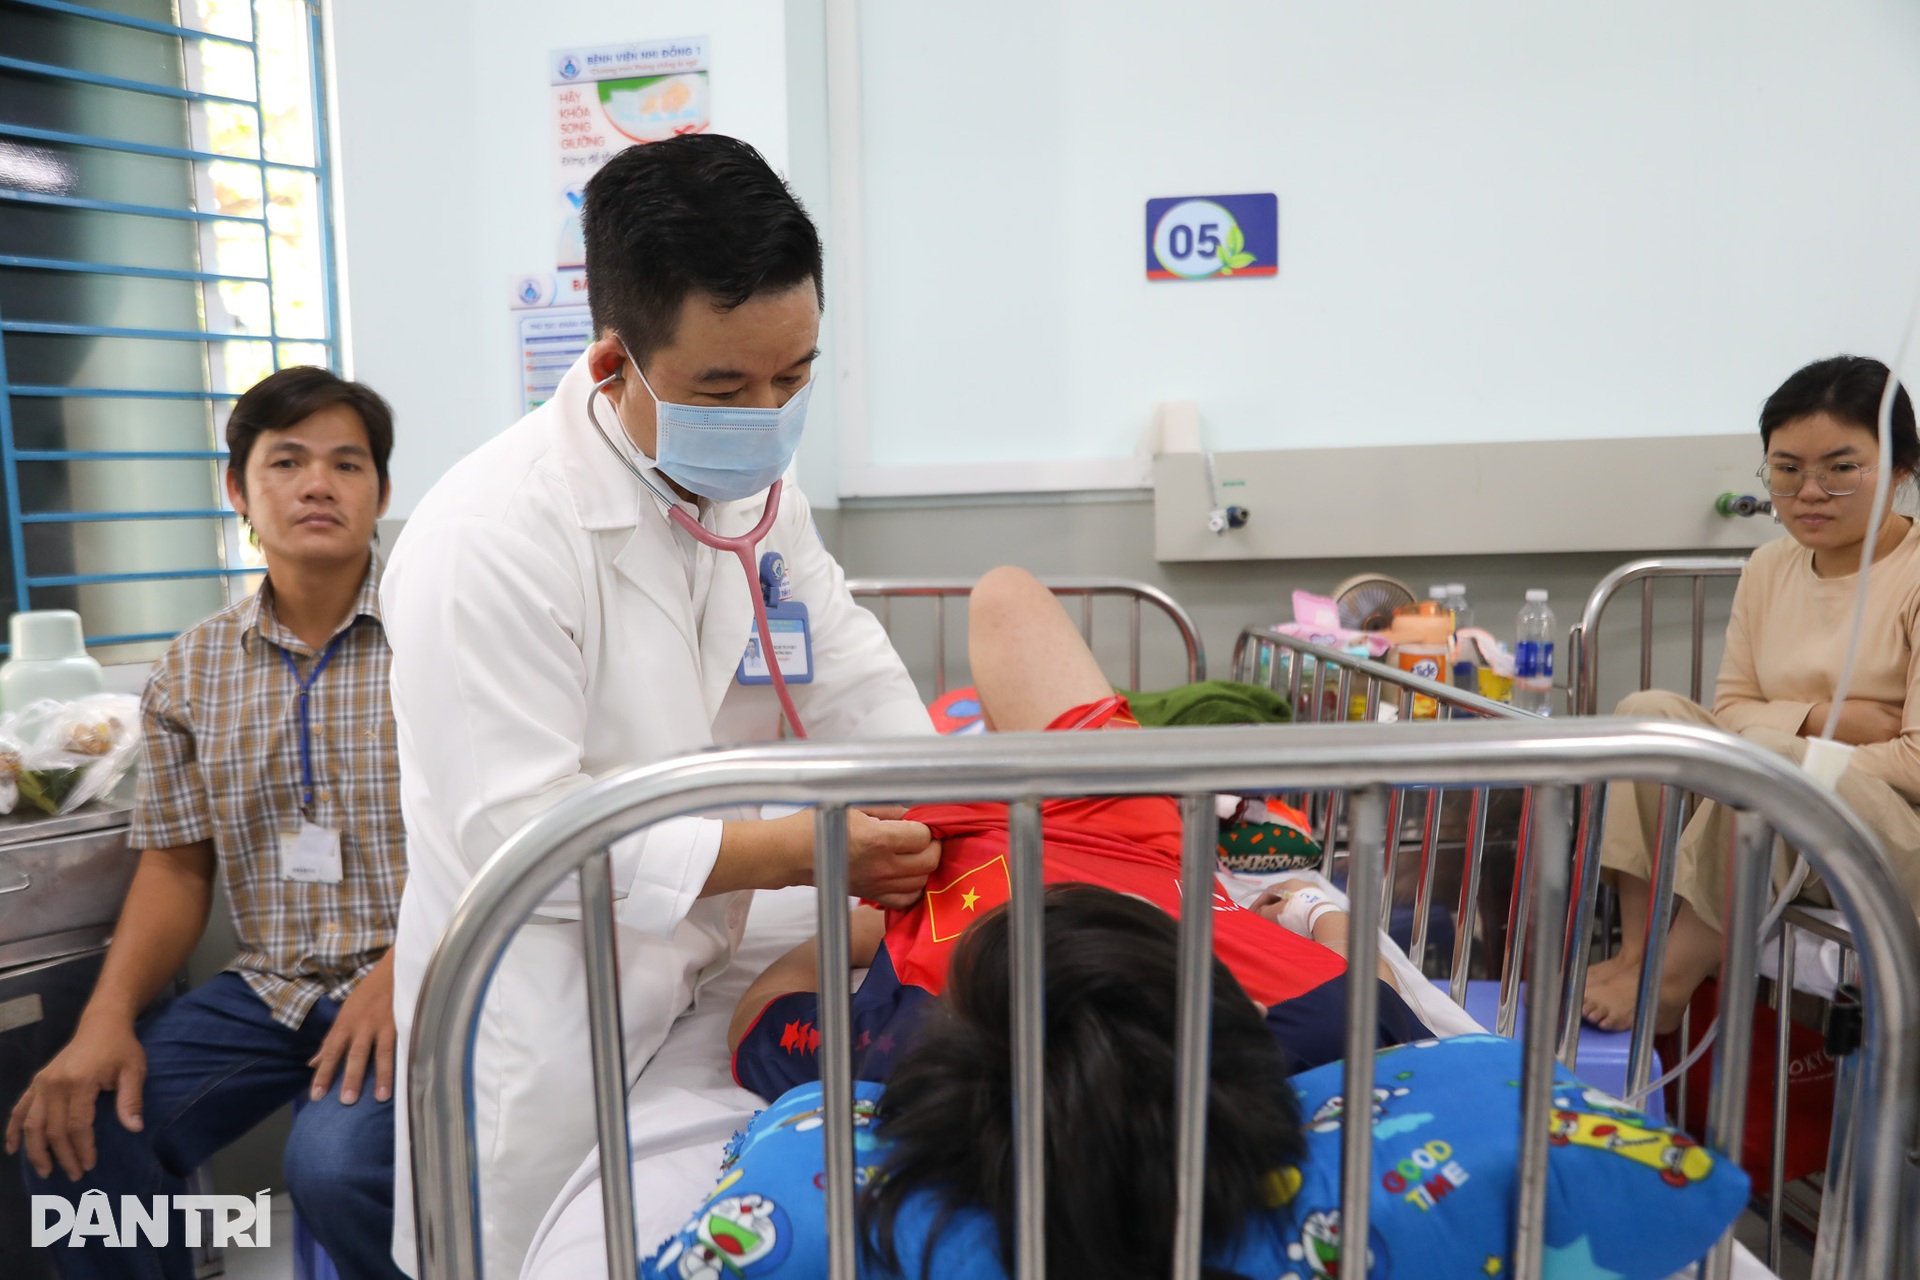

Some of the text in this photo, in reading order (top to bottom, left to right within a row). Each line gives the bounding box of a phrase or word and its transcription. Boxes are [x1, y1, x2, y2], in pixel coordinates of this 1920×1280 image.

[641, 50, 659, 61] NHI
[1169, 223, 1222, 261] 05
[1382, 1140, 1453, 1194] GOOD
[1405, 1160, 1470, 1212] TIME
